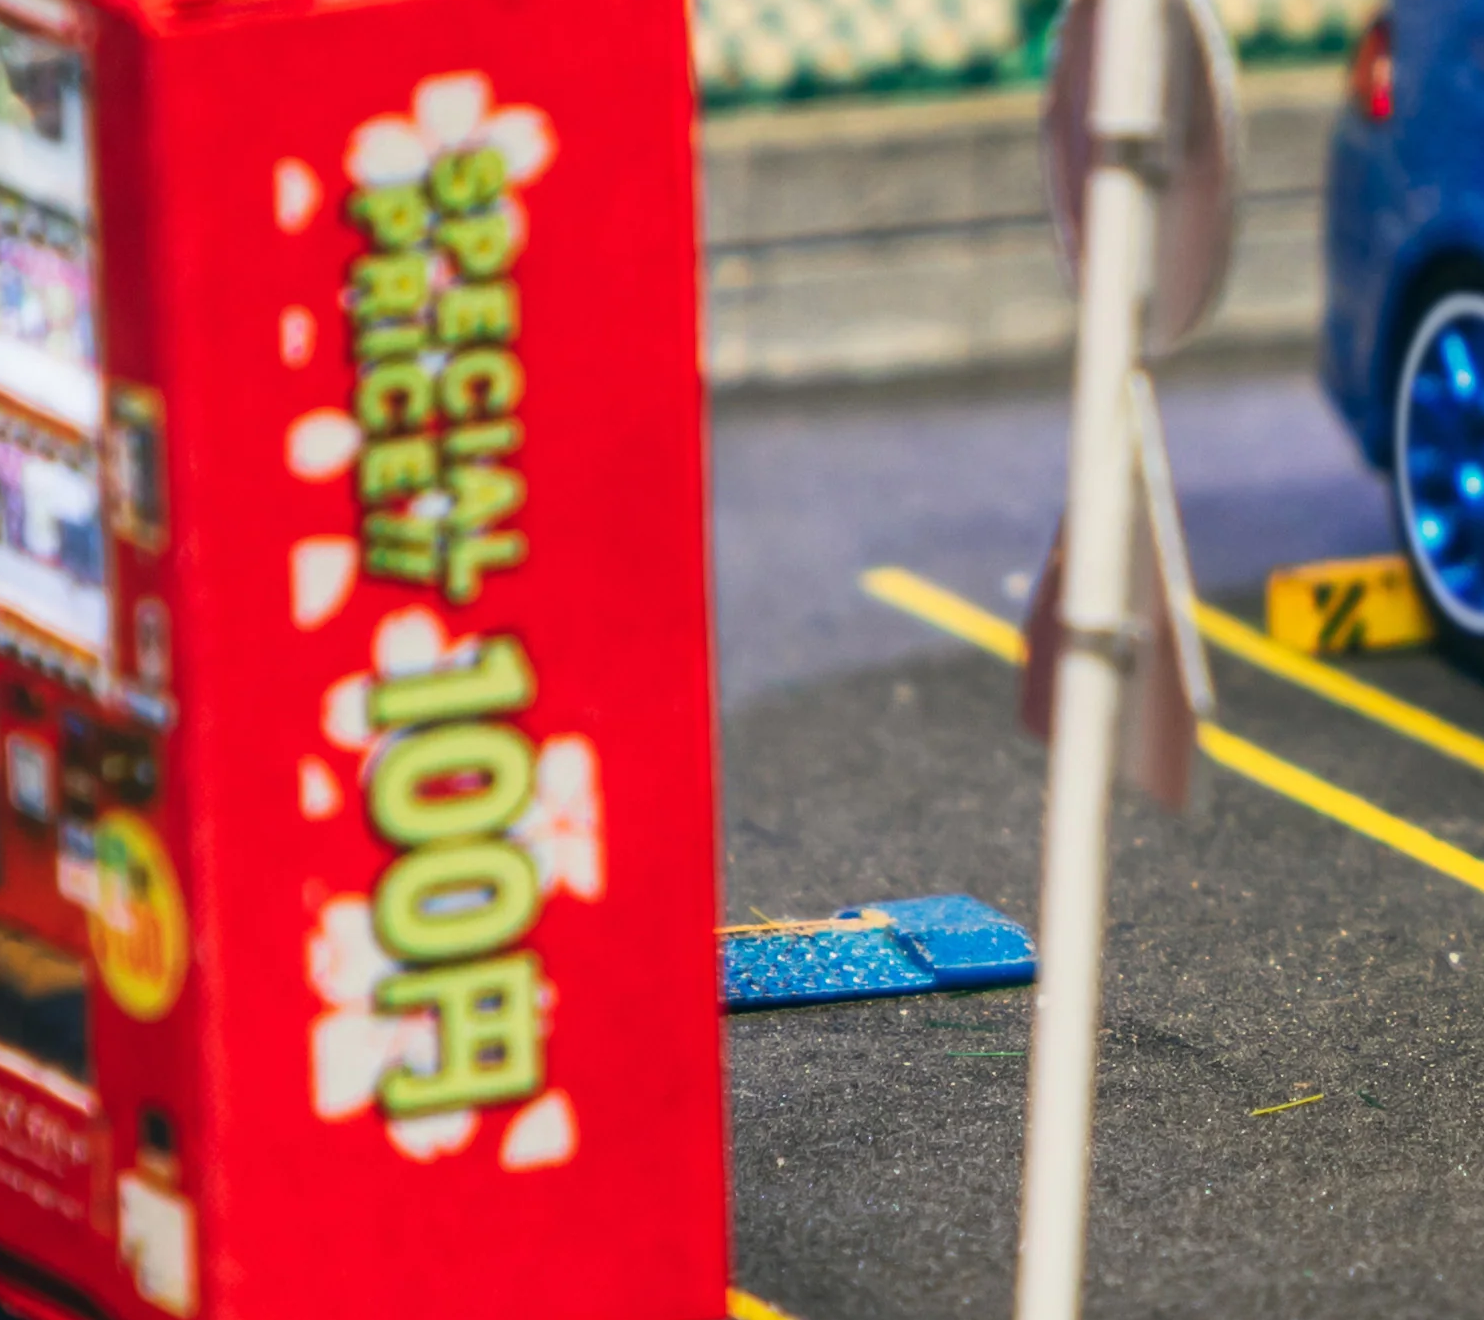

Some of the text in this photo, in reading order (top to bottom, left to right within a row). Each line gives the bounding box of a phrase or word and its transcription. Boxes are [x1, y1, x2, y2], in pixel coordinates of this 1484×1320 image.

[349, 186, 438, 587] PRICE!!
[428, 147, 526, 603] SPECIAL
[366, 633, 546, 1118] 100円
